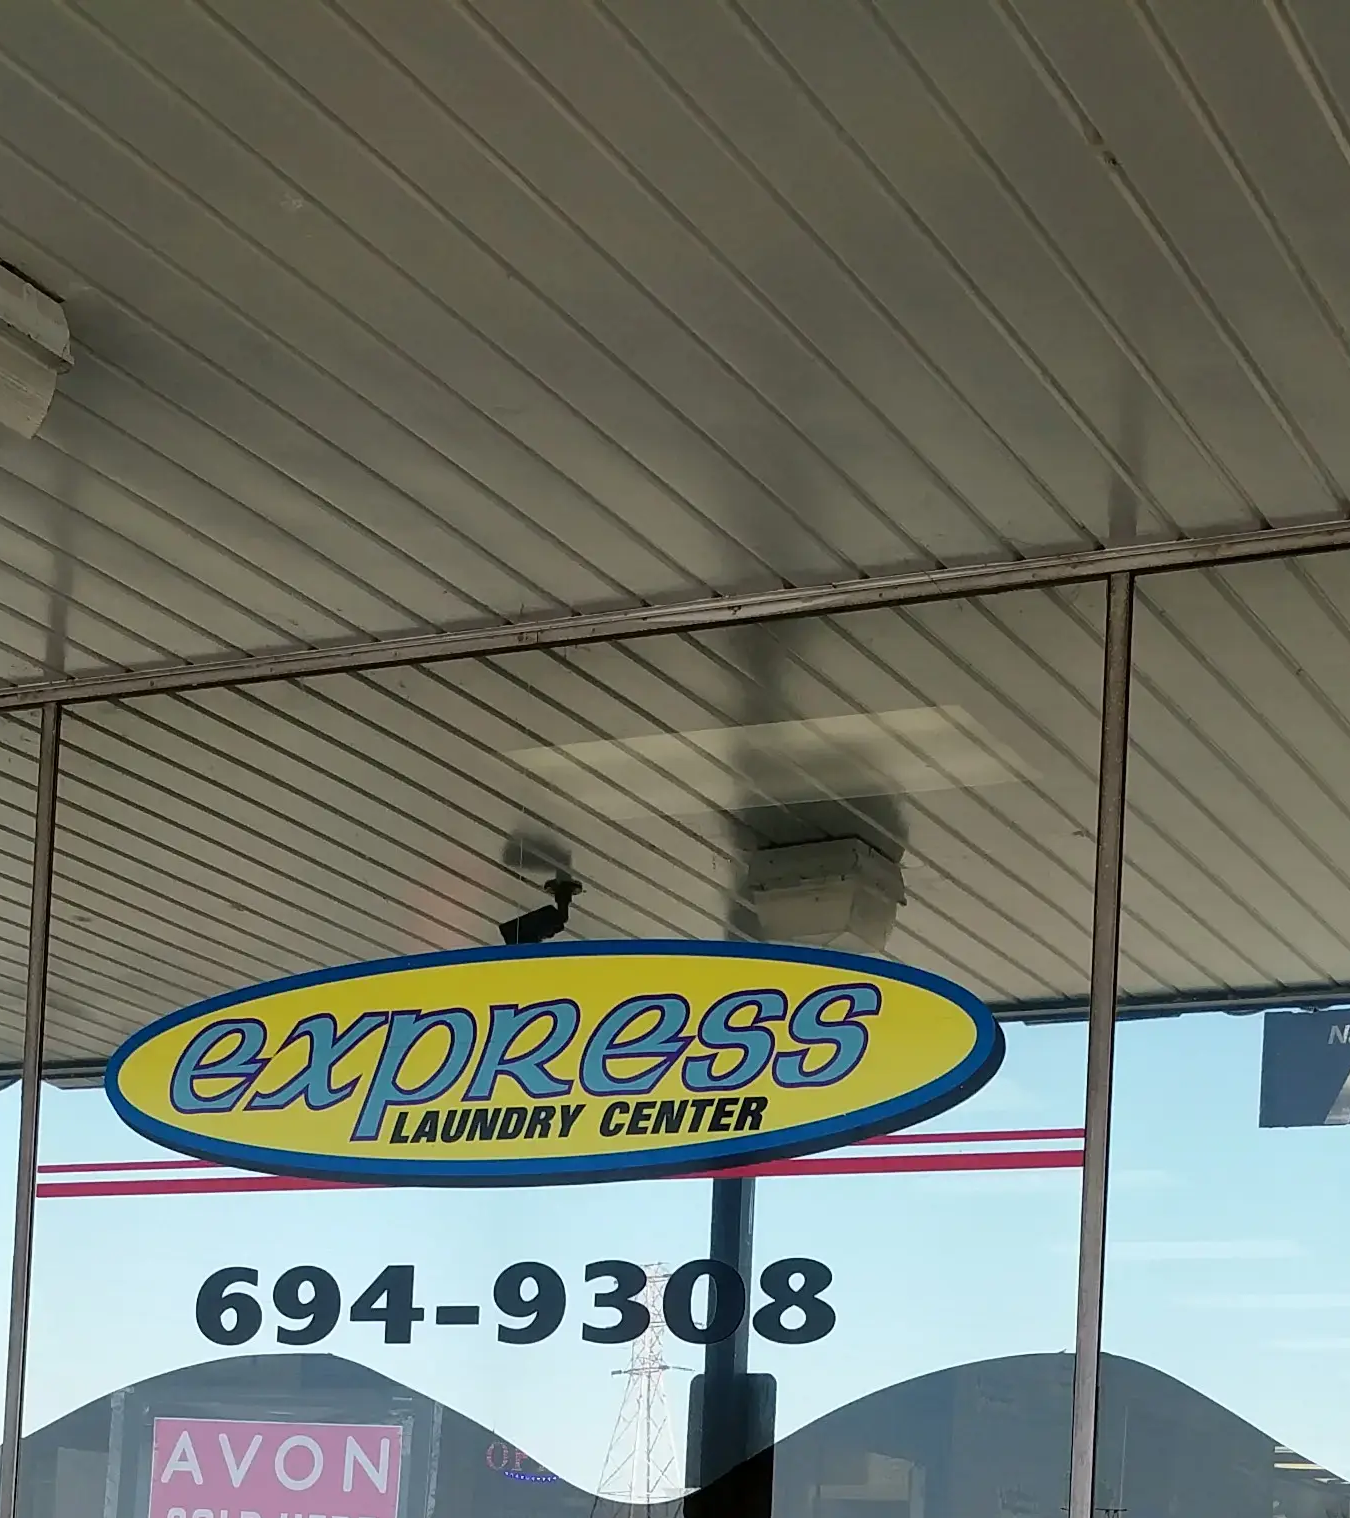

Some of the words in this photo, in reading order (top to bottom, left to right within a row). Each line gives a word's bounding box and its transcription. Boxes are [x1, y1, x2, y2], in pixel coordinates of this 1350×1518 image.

[389, 1103, 584, 1145] LAUNDRY
[598, 1095, 768, 1138] CENTER
[195, 1257, 836, 1347] 694-9308
[161, 1431, 390, 1493] AVON
